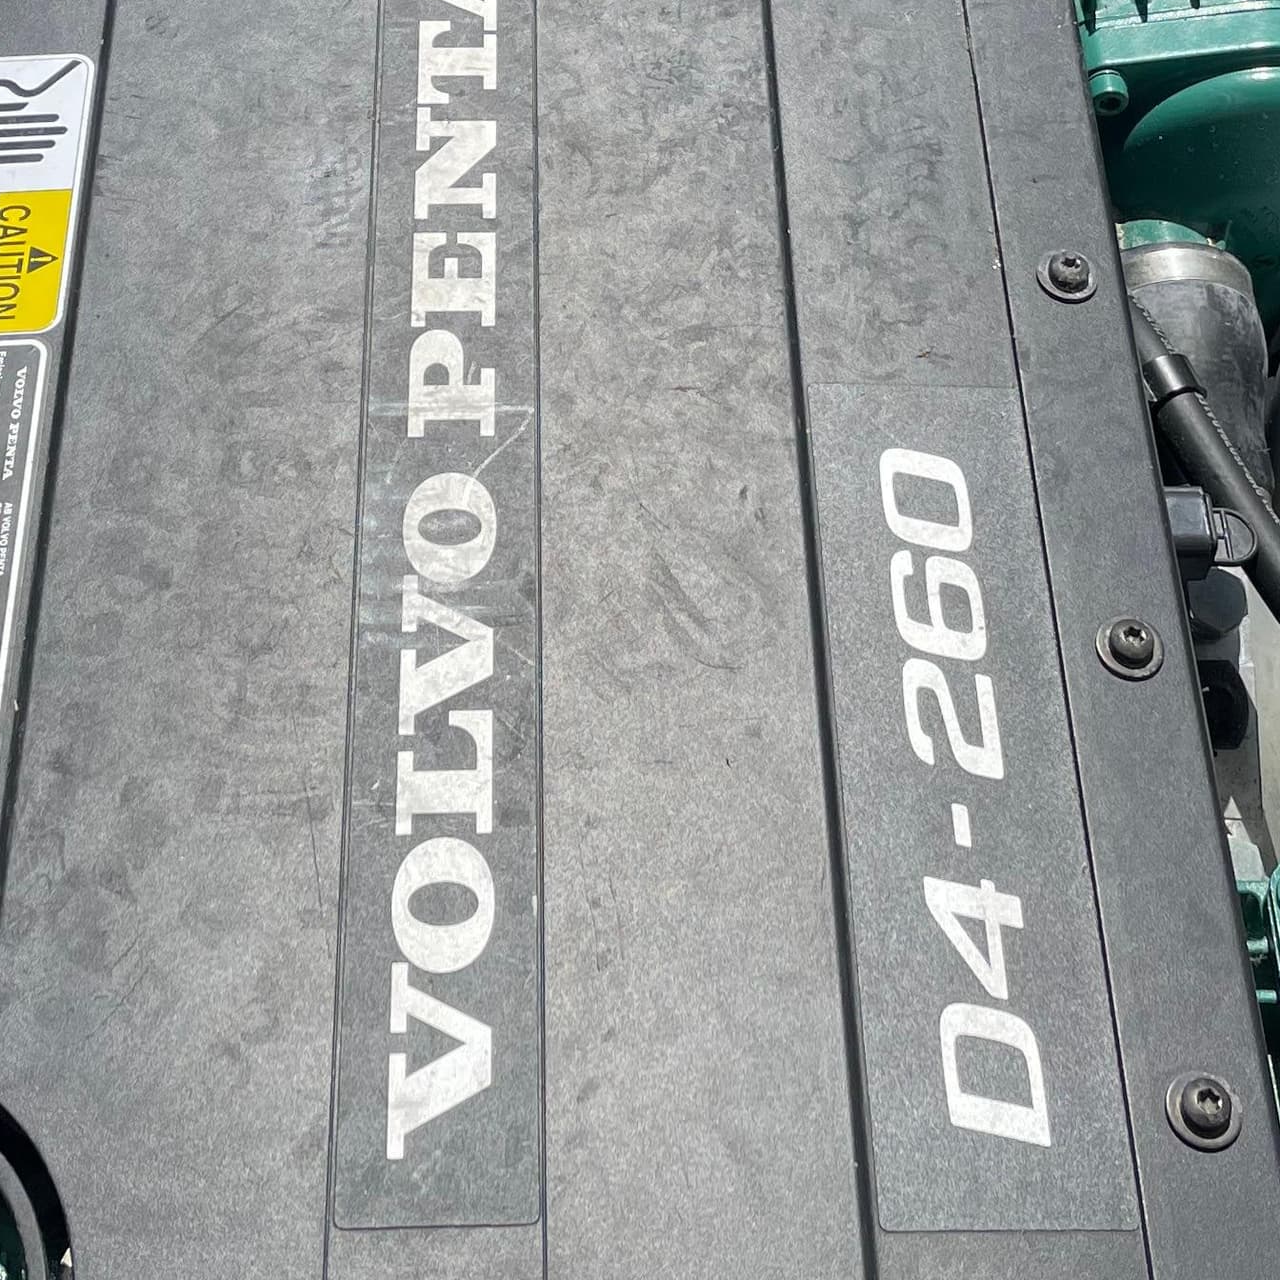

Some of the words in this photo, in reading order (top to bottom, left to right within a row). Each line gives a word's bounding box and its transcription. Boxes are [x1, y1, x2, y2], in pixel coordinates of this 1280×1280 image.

[9, 366, 27, 419] VOLVO
[1, 422, 19, 480] PENTA
[384, 469, 497, 1160] VOLVO
